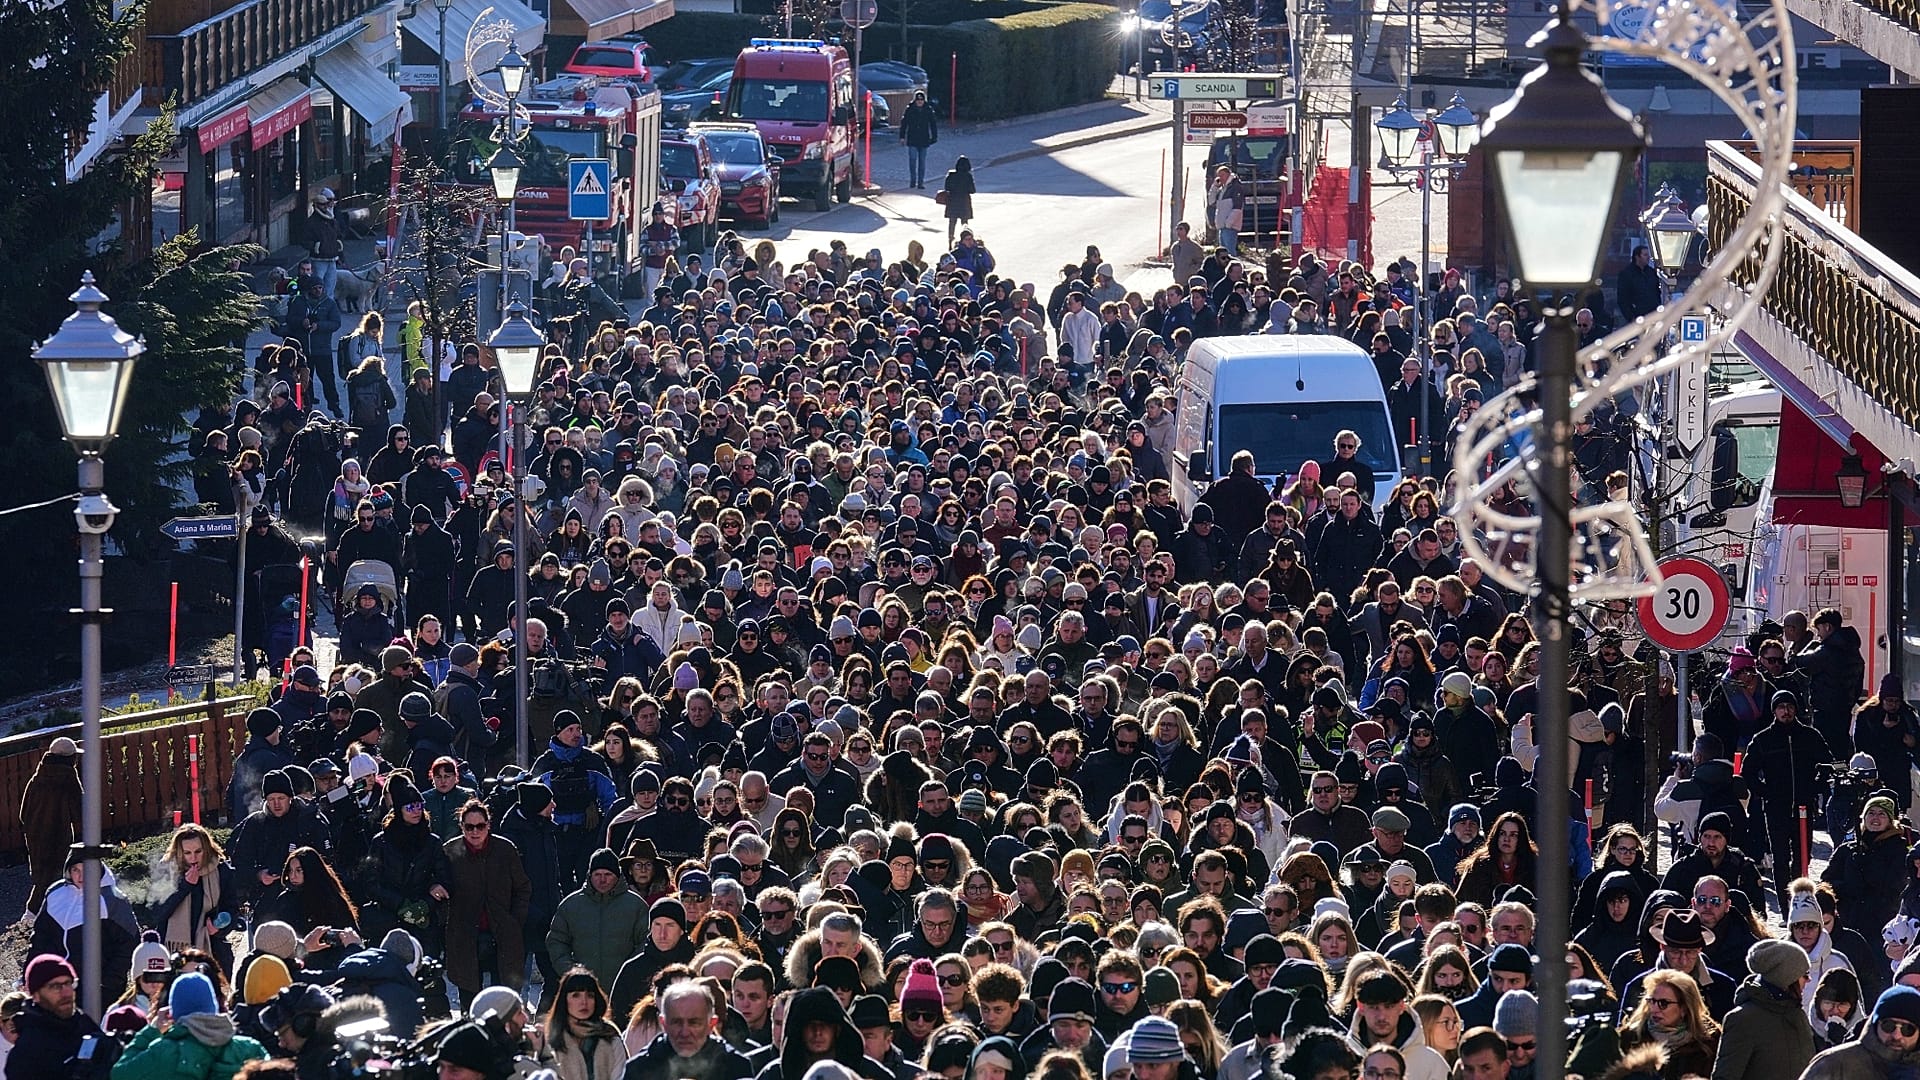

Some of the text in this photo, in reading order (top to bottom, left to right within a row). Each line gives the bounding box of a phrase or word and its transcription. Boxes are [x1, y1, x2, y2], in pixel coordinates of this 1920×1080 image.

[1168, 82, 1274, 96] P SCANDIA 4
[515, 190, 550, 200] CANIA
[1687, 361, 1696, 441] ICKET
[174, 523, 232, 534] Ariana & Marina
[1665, 588, 1700, 619] 30
